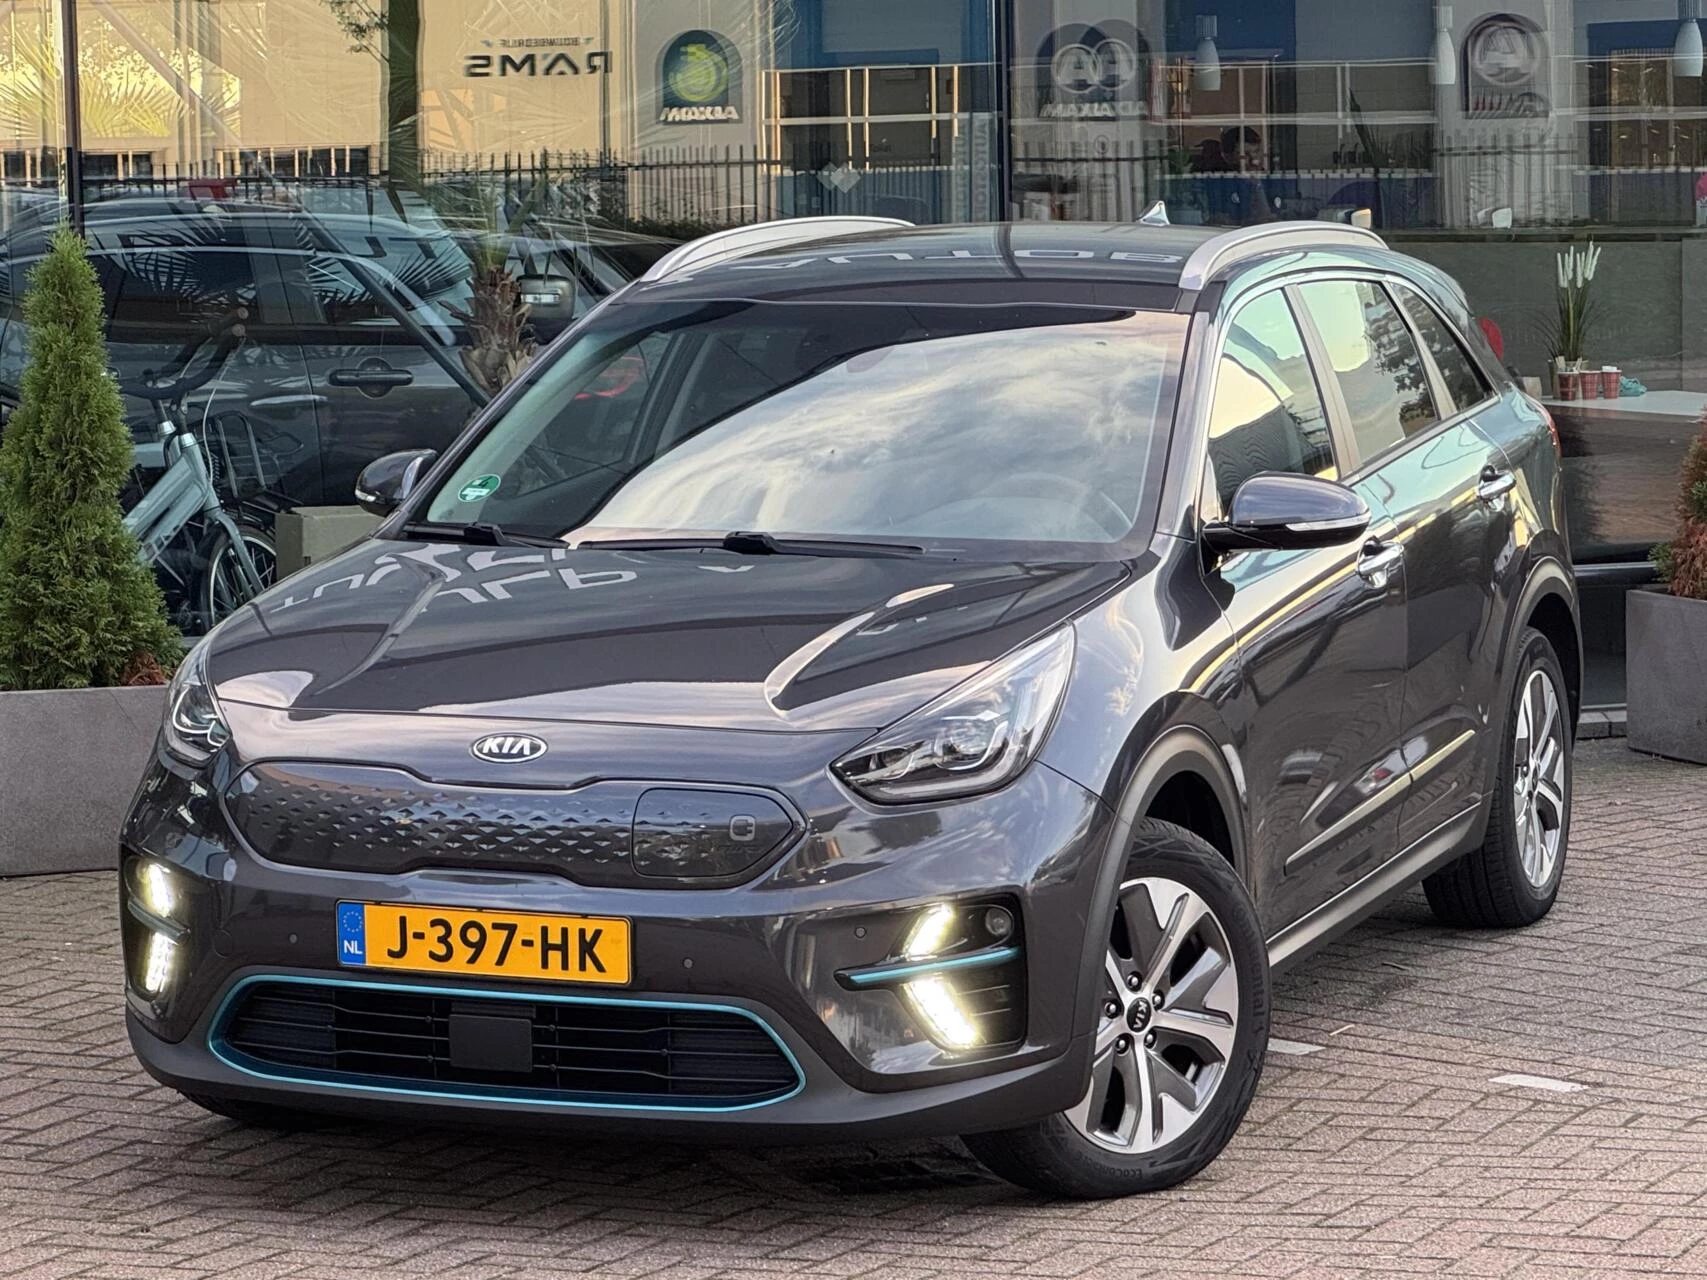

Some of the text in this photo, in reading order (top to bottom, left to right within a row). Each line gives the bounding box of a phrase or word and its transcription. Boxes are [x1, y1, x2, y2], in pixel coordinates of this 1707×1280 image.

[482, 735, 534, 756] KIA
[343, 939, 363, 955] NL
[387, 914, 607, 973] J-397-HK
[1133, 1000, 1148, 1028] KIA
